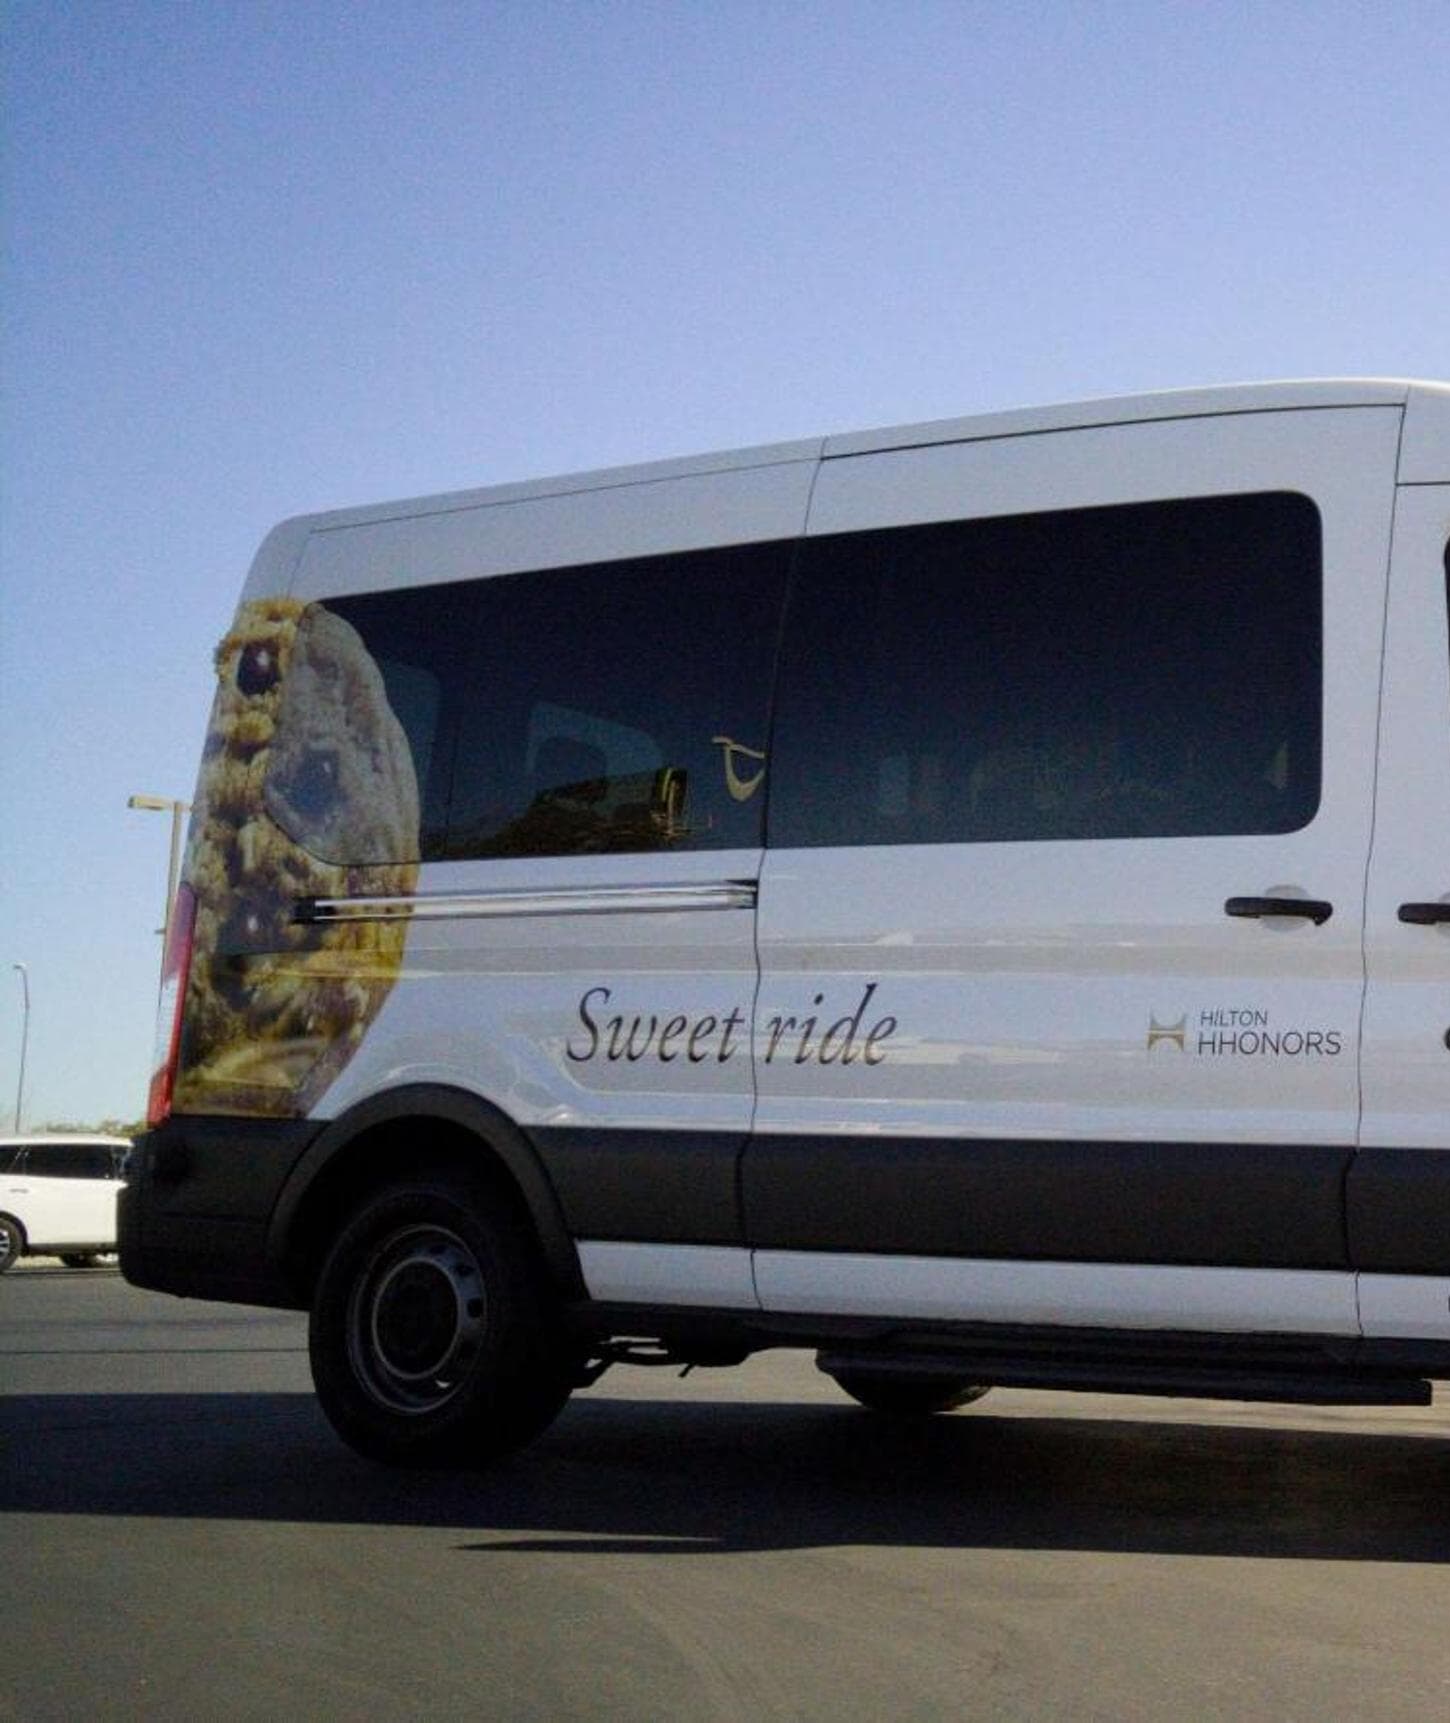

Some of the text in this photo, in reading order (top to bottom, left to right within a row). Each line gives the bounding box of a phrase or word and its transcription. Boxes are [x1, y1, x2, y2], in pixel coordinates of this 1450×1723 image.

[566, 982, 898, 1066] Sweet ride
[1200, 1010, 1268, 1027] HILTON
[1198, 1031, 1342, 1056] HHONORS
